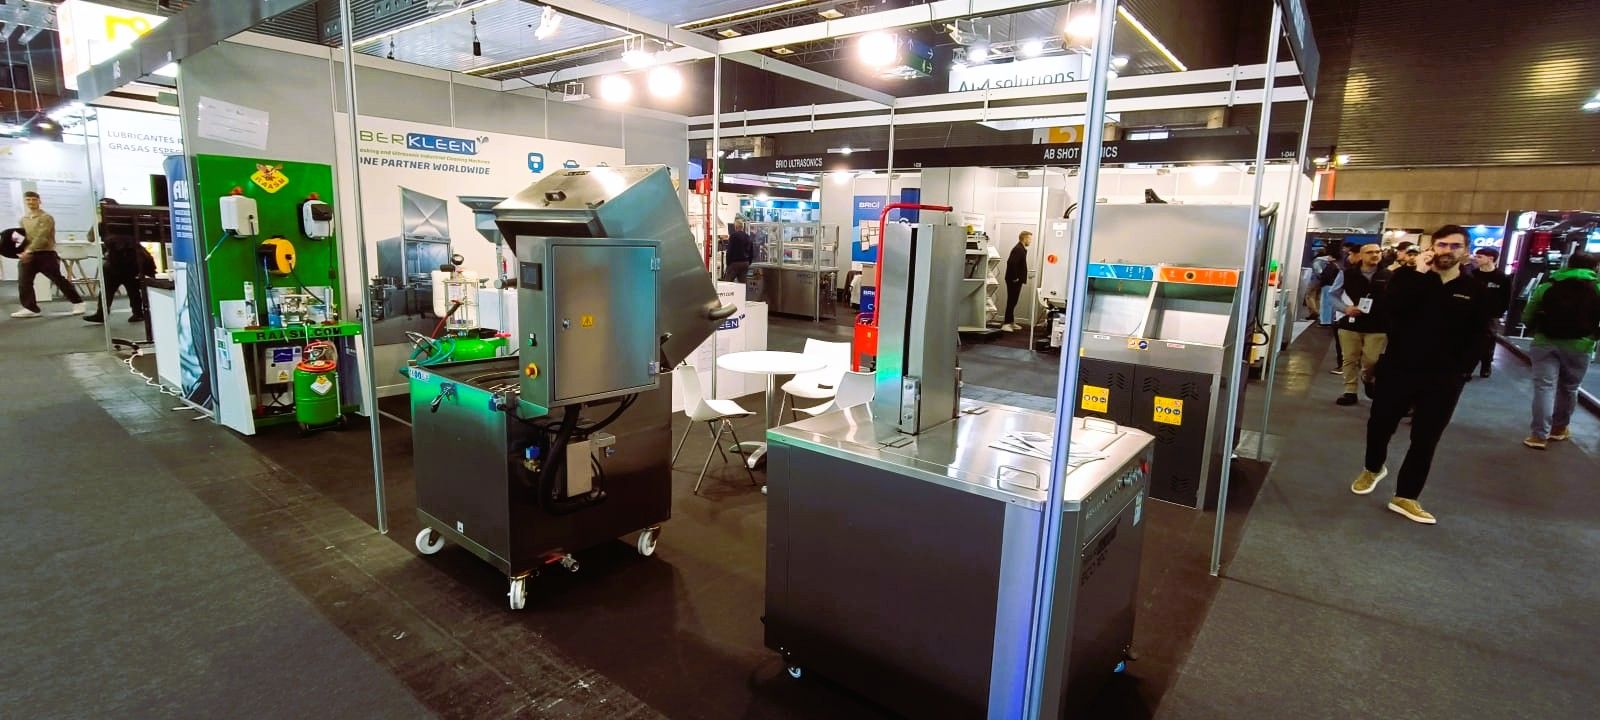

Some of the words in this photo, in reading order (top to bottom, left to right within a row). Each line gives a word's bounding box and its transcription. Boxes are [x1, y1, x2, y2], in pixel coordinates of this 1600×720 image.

[995, 71, 1075, 88] solutions
[107, 130, 174, 143] LUBRICANTES
[109, 143, 150, 152] GRASAS
[1044, 148, 1055, 160] AB
[1057, 147, 1080, 160] SHOT
[381, 158, 430, 170] PARTNER
[433, 163, 490, 175] WORLDWIDE
[775, 159, 788, 169] BRIO
[788, 157, 823, 168] ULTRASONICS
